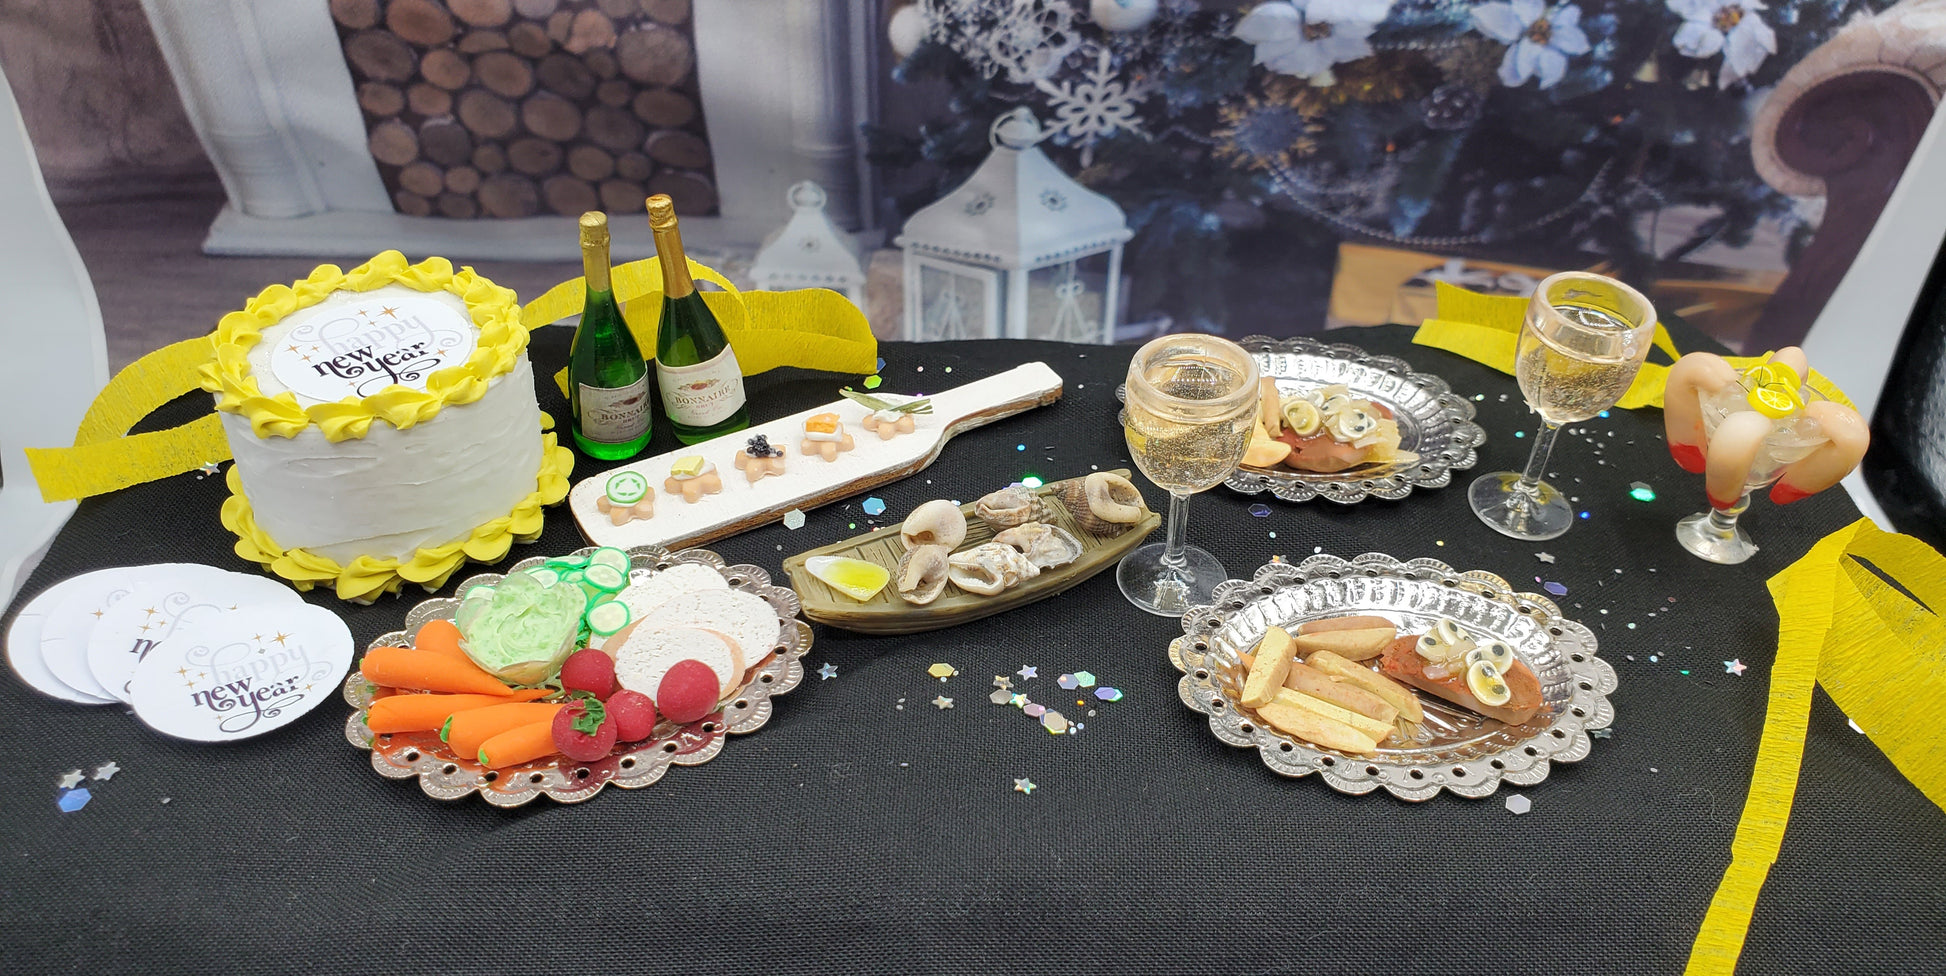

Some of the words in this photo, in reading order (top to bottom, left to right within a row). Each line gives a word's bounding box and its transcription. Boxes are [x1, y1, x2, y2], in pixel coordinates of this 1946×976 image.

[290, 316, 463, 356] happy
[311, 345, 377, 379] new
[356, 341, 441, 399] year
[674, 384, 731, 405] BONNAIRE
[185, 642, 334, 688] happy
[191, 675, 253, 712] new
[219, 675, 305, 733] year
